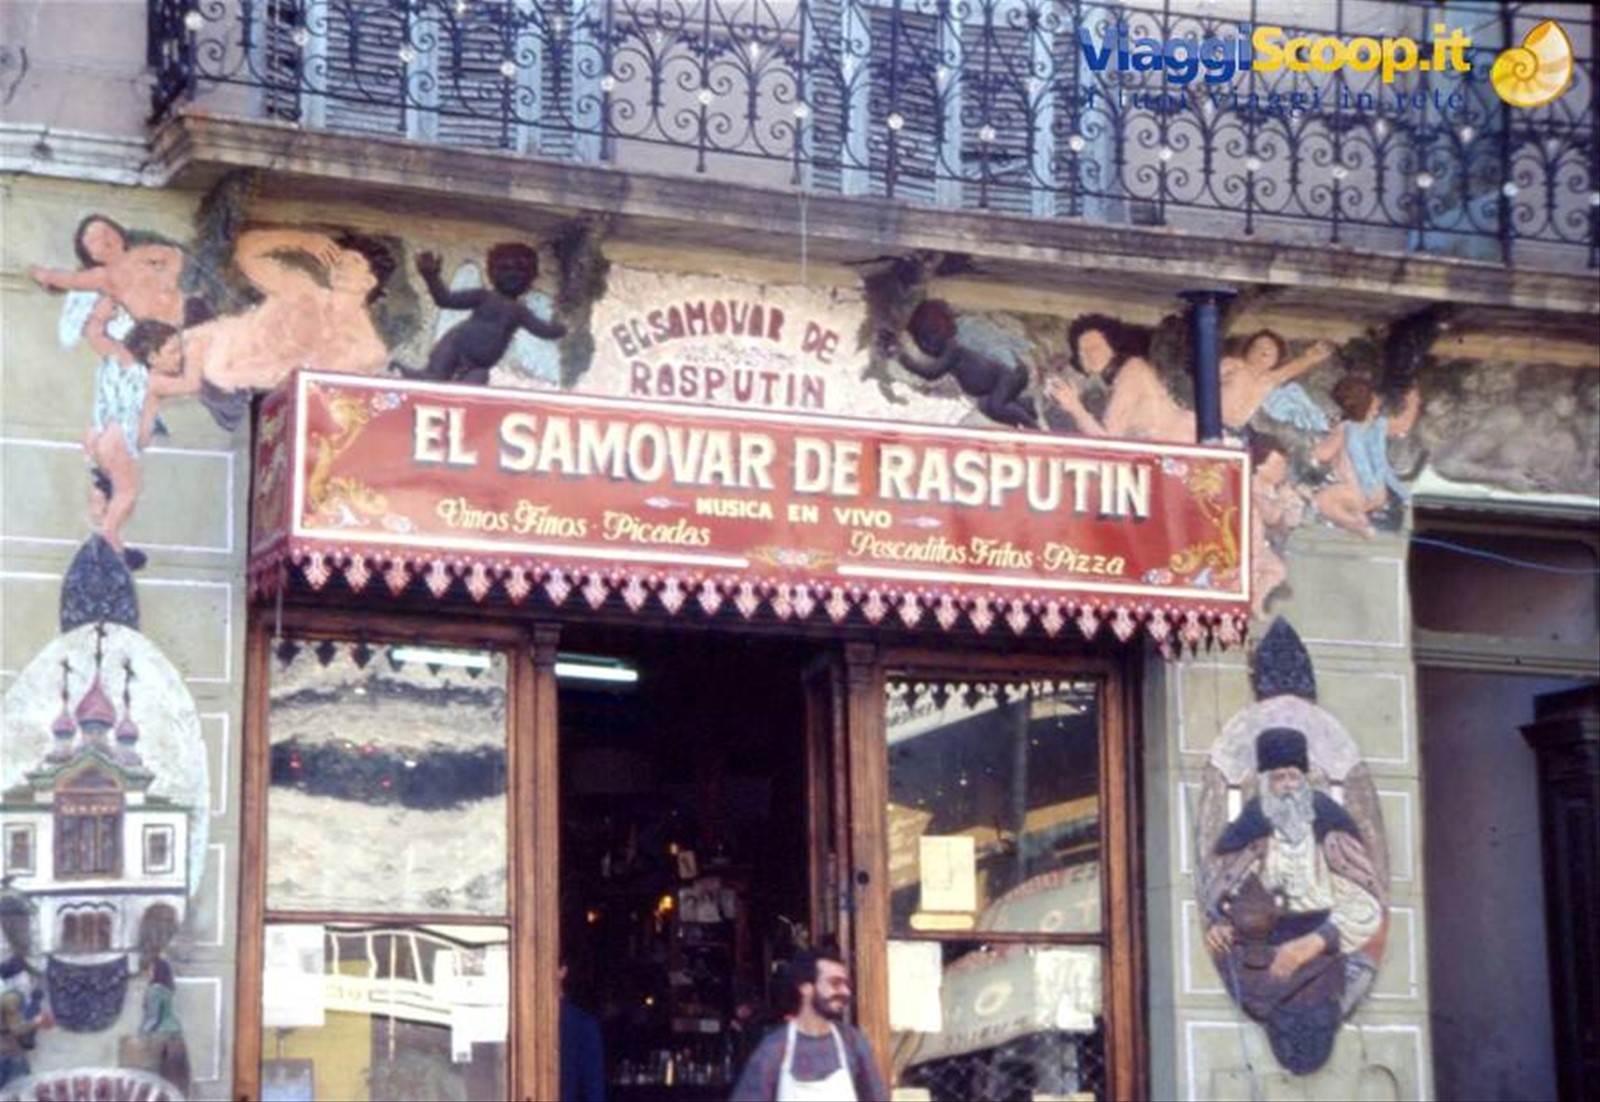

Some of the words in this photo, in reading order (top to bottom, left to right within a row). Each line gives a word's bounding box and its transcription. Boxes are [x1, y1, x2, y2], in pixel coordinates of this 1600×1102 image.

[648, 300, 784, 343] SAMOVAR
[801, 321, 839, 364] DE
[630, 361, 825, 409] RASPUTIN
[413, 405, 478, 467] EL
[500, 413, 776, 492] SAMOVAR
[794, 437, 863, 497] DE
[879, 444, 1151, 517] RASPUTIN
[436, 497, 509, 531] Vinos
[512, 499, 588, 537] Finos
[602, 510, 712, 546] Picadas
[696, 498, 773, 520] MUSICA
[788, 505, 818, 524] EN
[833, 508, 893, 529] VIVO
[848, 530, 967, 565] Pescaditos
[968, 536, 1034, 569] Fritos
[1043, 541, 1126, 576] Pizza
